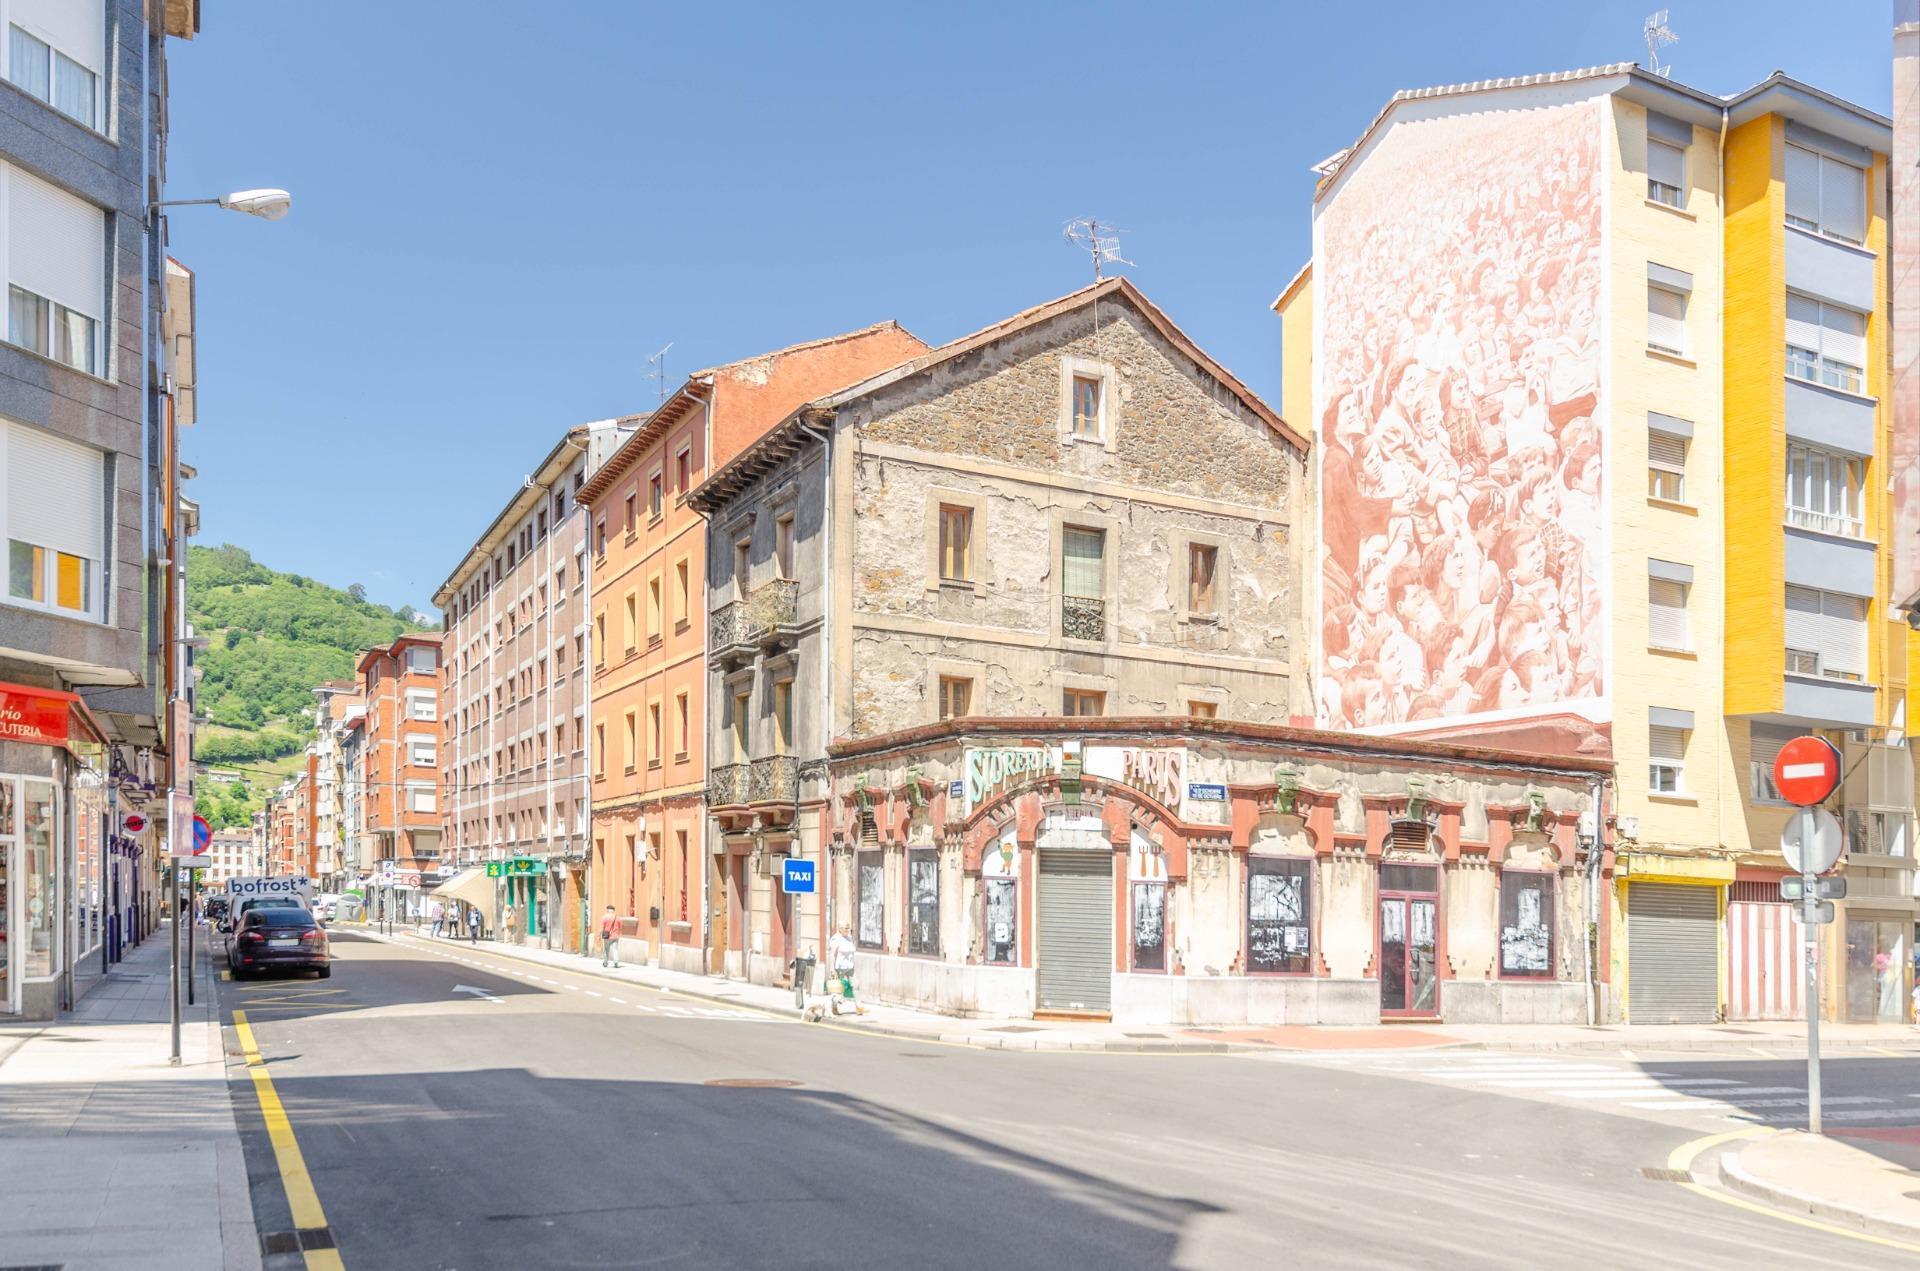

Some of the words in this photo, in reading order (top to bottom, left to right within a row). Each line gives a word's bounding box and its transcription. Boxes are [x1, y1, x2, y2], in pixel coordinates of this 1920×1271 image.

[971, 751, 1054, 802] SIDRERIA
[1123, 750, 1180, 806] PARIS
[788, 871, 812, 881] TAXI
